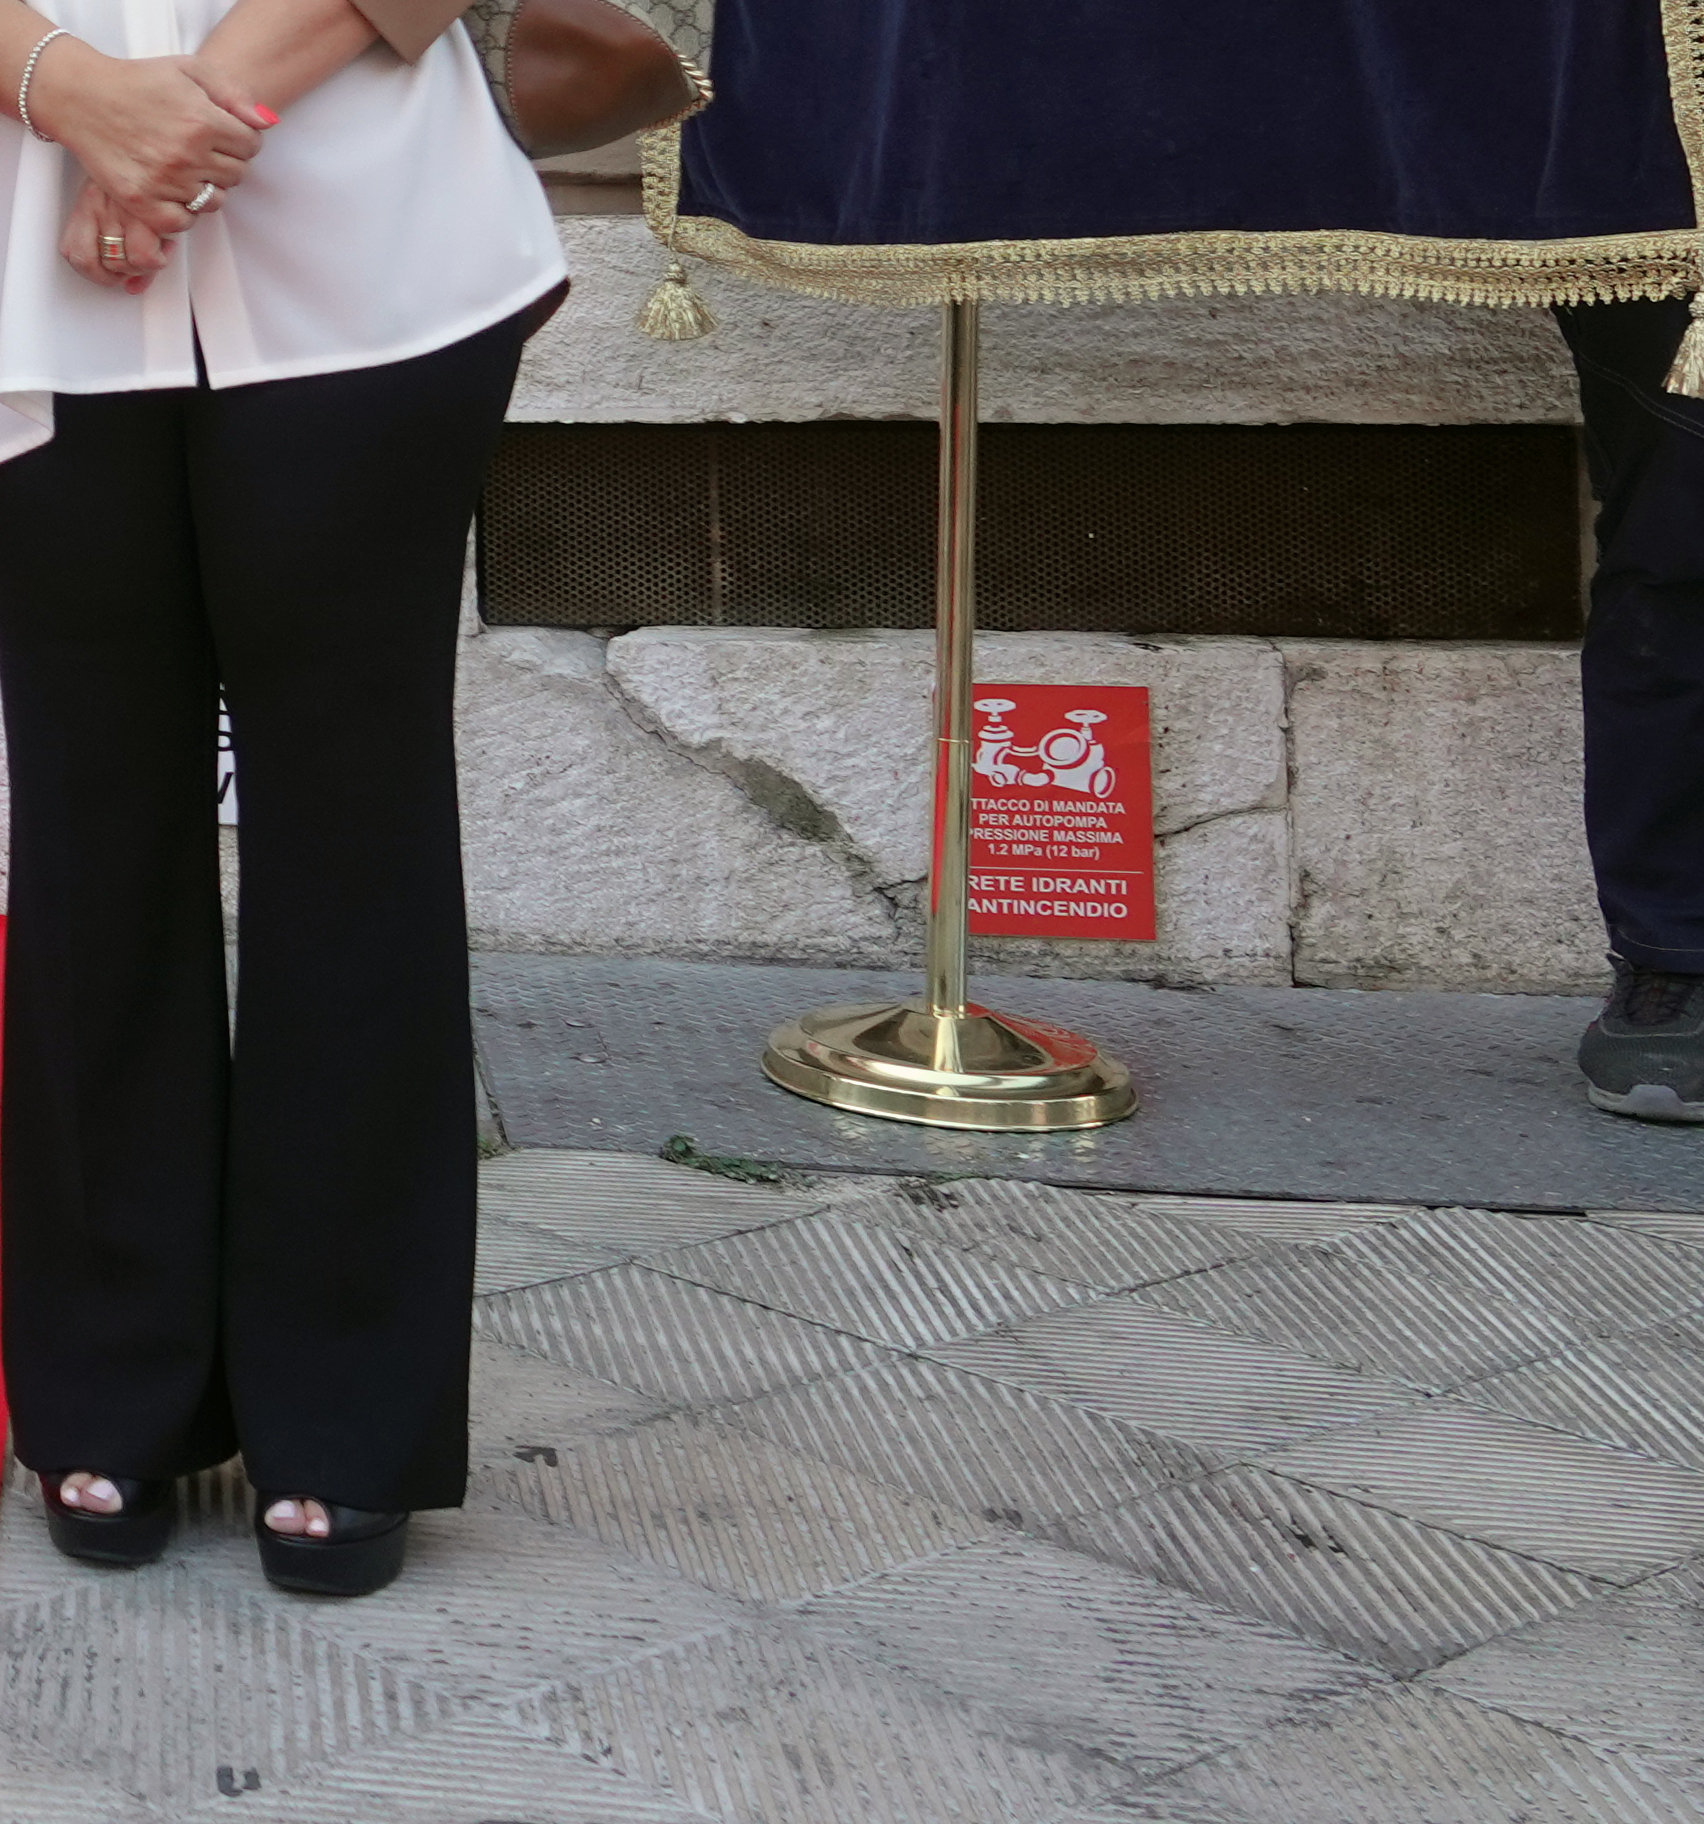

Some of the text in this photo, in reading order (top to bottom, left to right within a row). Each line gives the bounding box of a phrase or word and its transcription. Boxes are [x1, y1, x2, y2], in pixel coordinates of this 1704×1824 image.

[970, 797, 1126, 814] TTACCO DI MANDATA
[979, 813, 1108, 828] PER AUTOPOMPA
[1053, 830, 1124, 844] MASSIMA
[988, 843, 1100, 861] 1.2 MPa (12 bar)
[968, 875, 1127, 895] RETE IDRANTI
[968, 898, 1128, 919] ANTINCENDIO
